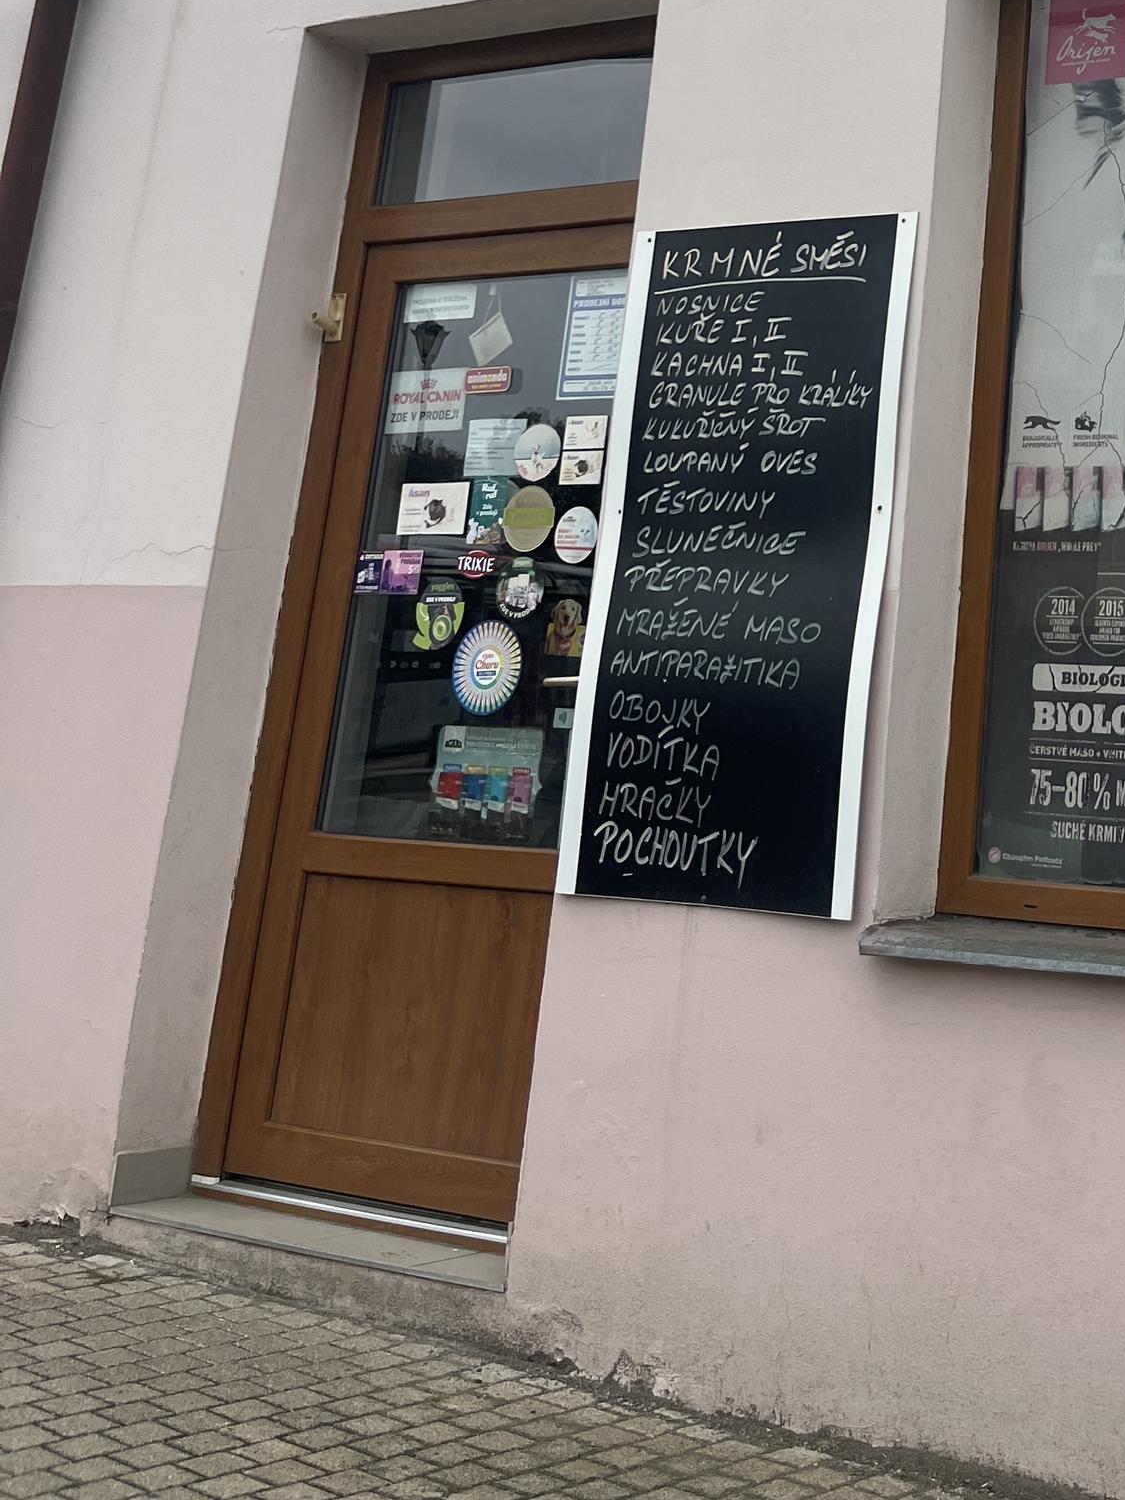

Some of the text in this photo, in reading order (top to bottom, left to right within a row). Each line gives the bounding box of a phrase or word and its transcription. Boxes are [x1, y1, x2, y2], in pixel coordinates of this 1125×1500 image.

[1056, 35, 1116, 75] Orijen
[661, 230, 867, 281] KRMNÉ SMĚSI
[655, 291, 765, 316] NOSNICE
[655, 312, 724, 346] KUŘE
[650, 351, 744, 378] KACHNA
[394, 388, 462, 406] ROYAL CANIN
[648, 381, 747, 409] GRANULE
[752, 382, 790, 406] PRO
[798, 369, 873, 409] KRÁLÍKY
[391, 409, 459, 423] ZDE V PRODEJI
[758, 408, 826, 437] ŠROT
[643, 443, 818, 475] LOUPANÝ OVES
[637, 480, 776, 519] TĚSTOVINY
[632, 521, 806, 558] SLUNEČNICE
[457, 556, 495, 573] TRIXIE
[624, 558, 789, 598] PŘEPRAVKY
[616, 597, 822, 644] MRAŽENÉ MASO
[1051, 598, 1075, 615] 2014
[1098, 599, 1124, 617] 2015
[609, 689, 711, 735] OBOJKY
[606, 725, 720, 781] VODÍTKA
[1029, 742, 1068, 756] ČERSTVÉ
[1069, 747, 1094, 758] MASO
[598, 777, 712, 828] HRAČKY
[1050, 819, 1086, 840] SUCHÉ
[594, 820, 757, 889] POCHOUTKY
